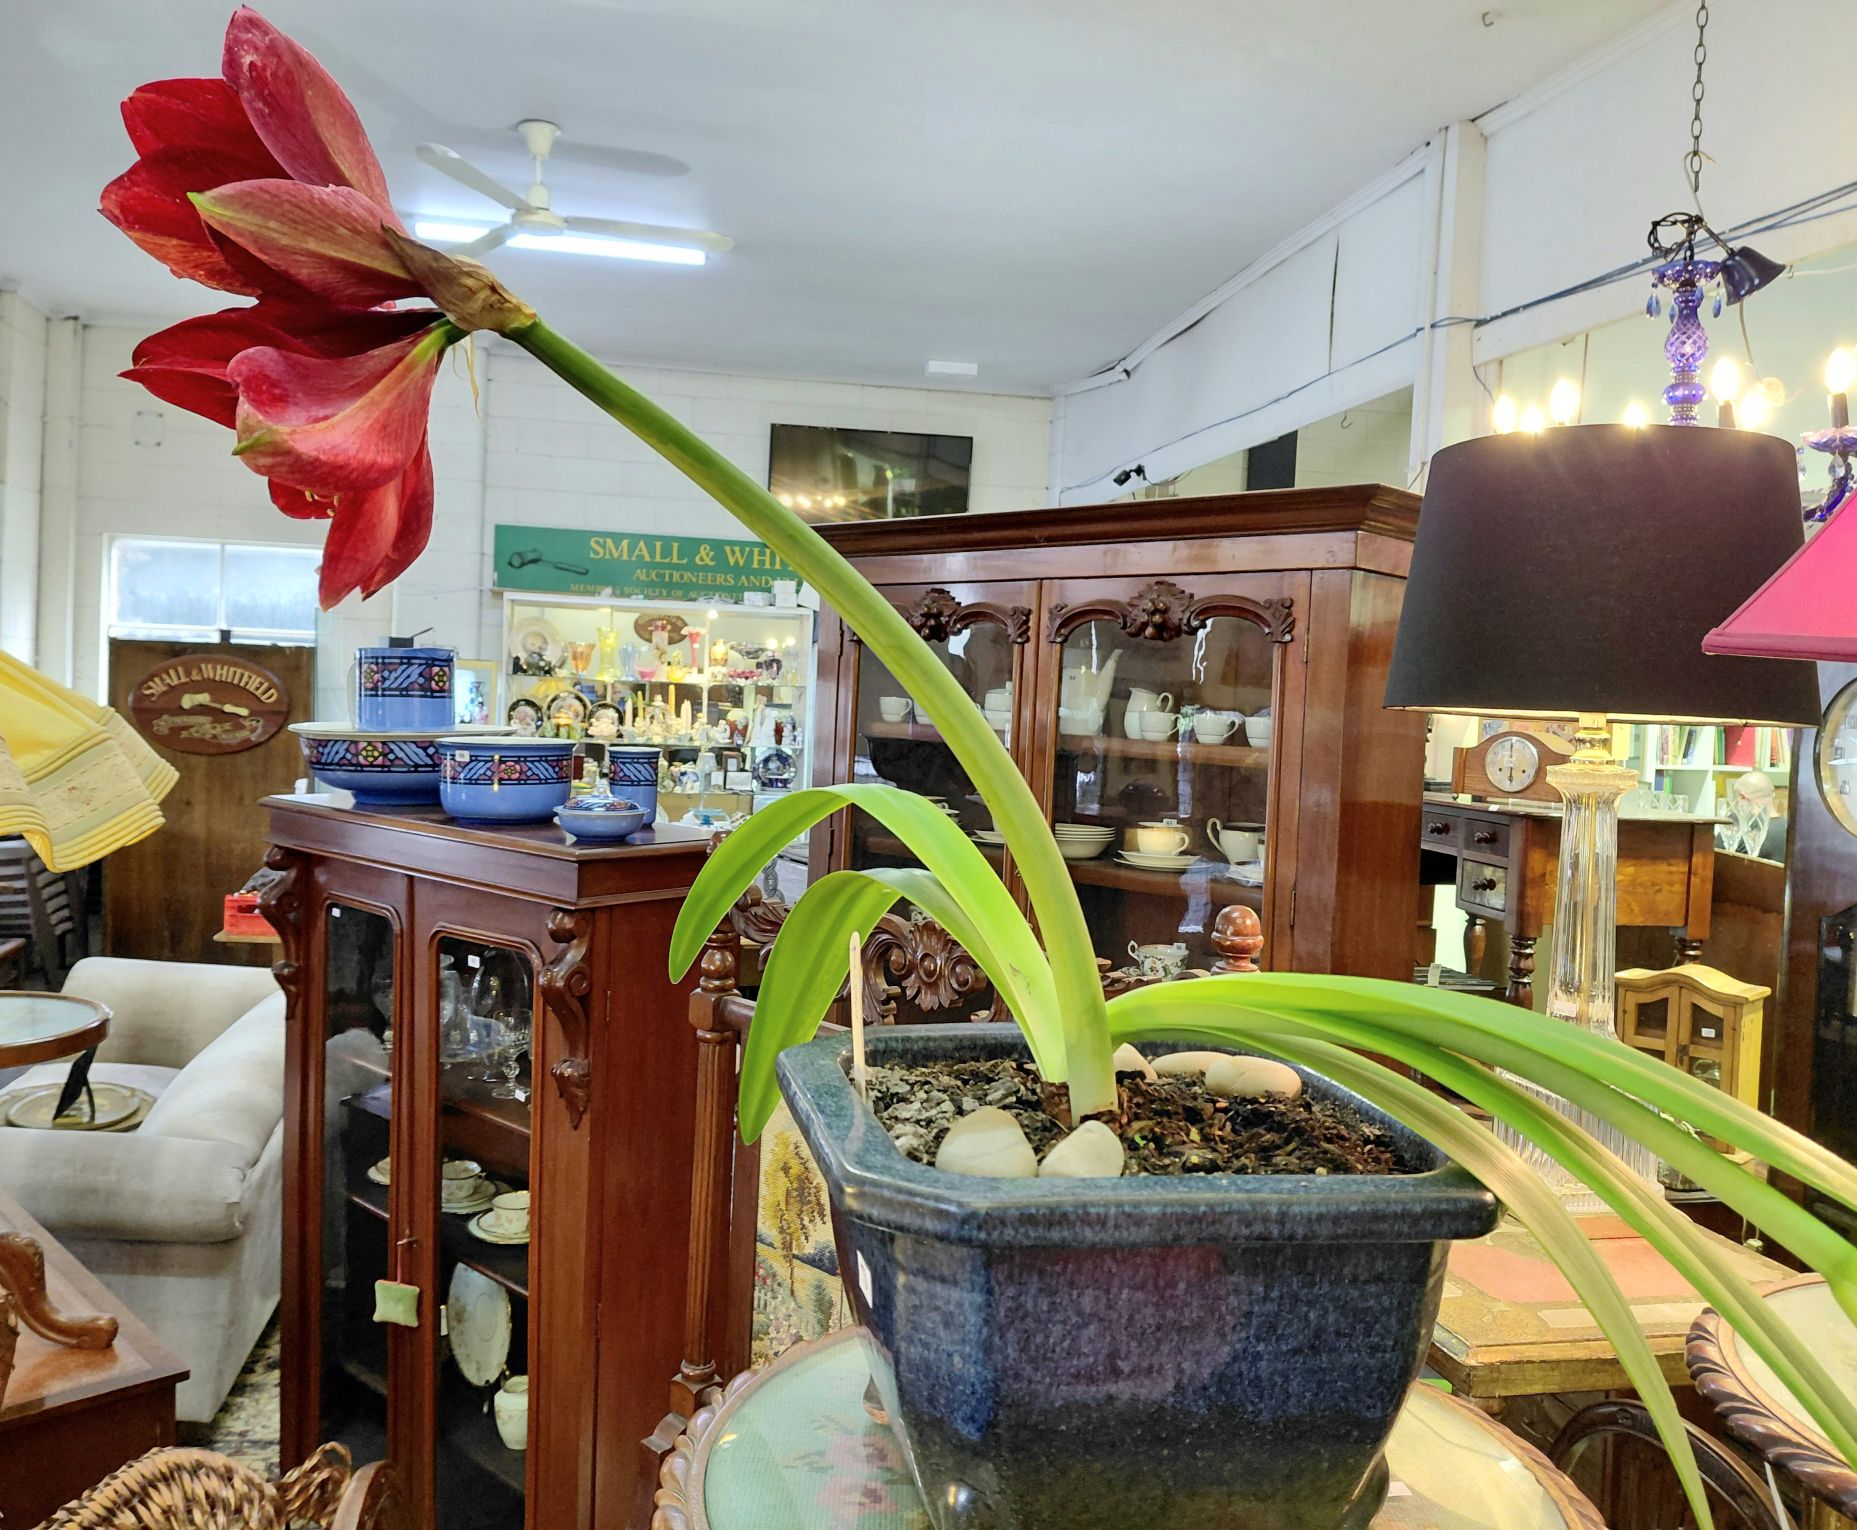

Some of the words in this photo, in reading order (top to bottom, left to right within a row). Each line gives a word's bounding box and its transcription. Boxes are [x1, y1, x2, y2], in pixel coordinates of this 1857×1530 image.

[589, 537, 688, 564] SMALL
[695, 543, 717, 566] &
[724, 546, 796, 571] WHI
[632, 569, 735, 587] AUCTIONEERS
[737, 575, 775, 589] AND
[142, 666, 191, 701] SMALL
[190, 668, 202, 681] &
[200, 663, 279, 704] WHITFIELD
